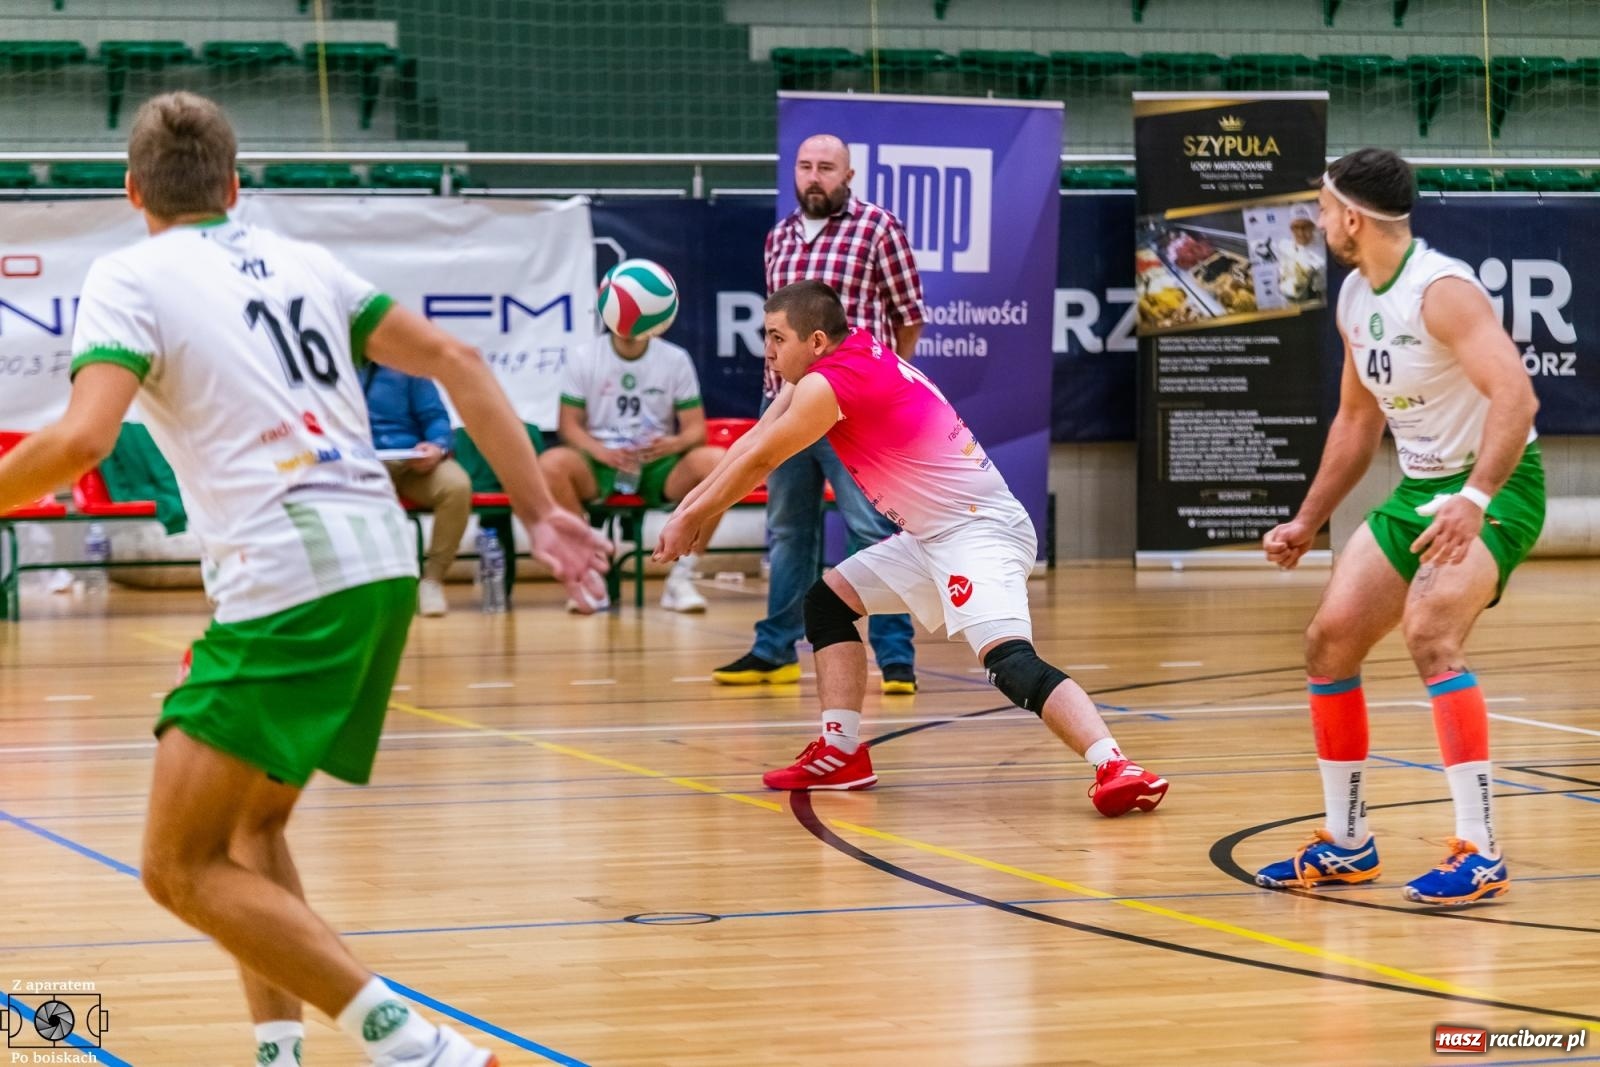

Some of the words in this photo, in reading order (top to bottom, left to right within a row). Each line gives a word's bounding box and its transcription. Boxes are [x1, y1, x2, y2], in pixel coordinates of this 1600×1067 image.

[1183, 135, 1281, 157] SZYPUŁA
[0, 296, 80, 336] N
[242, 296, 340, 389] 16
[1367, 348, 1392, 385] 49
[617, 395, 641, 417] 99
[826, 721, 844, 733] R
